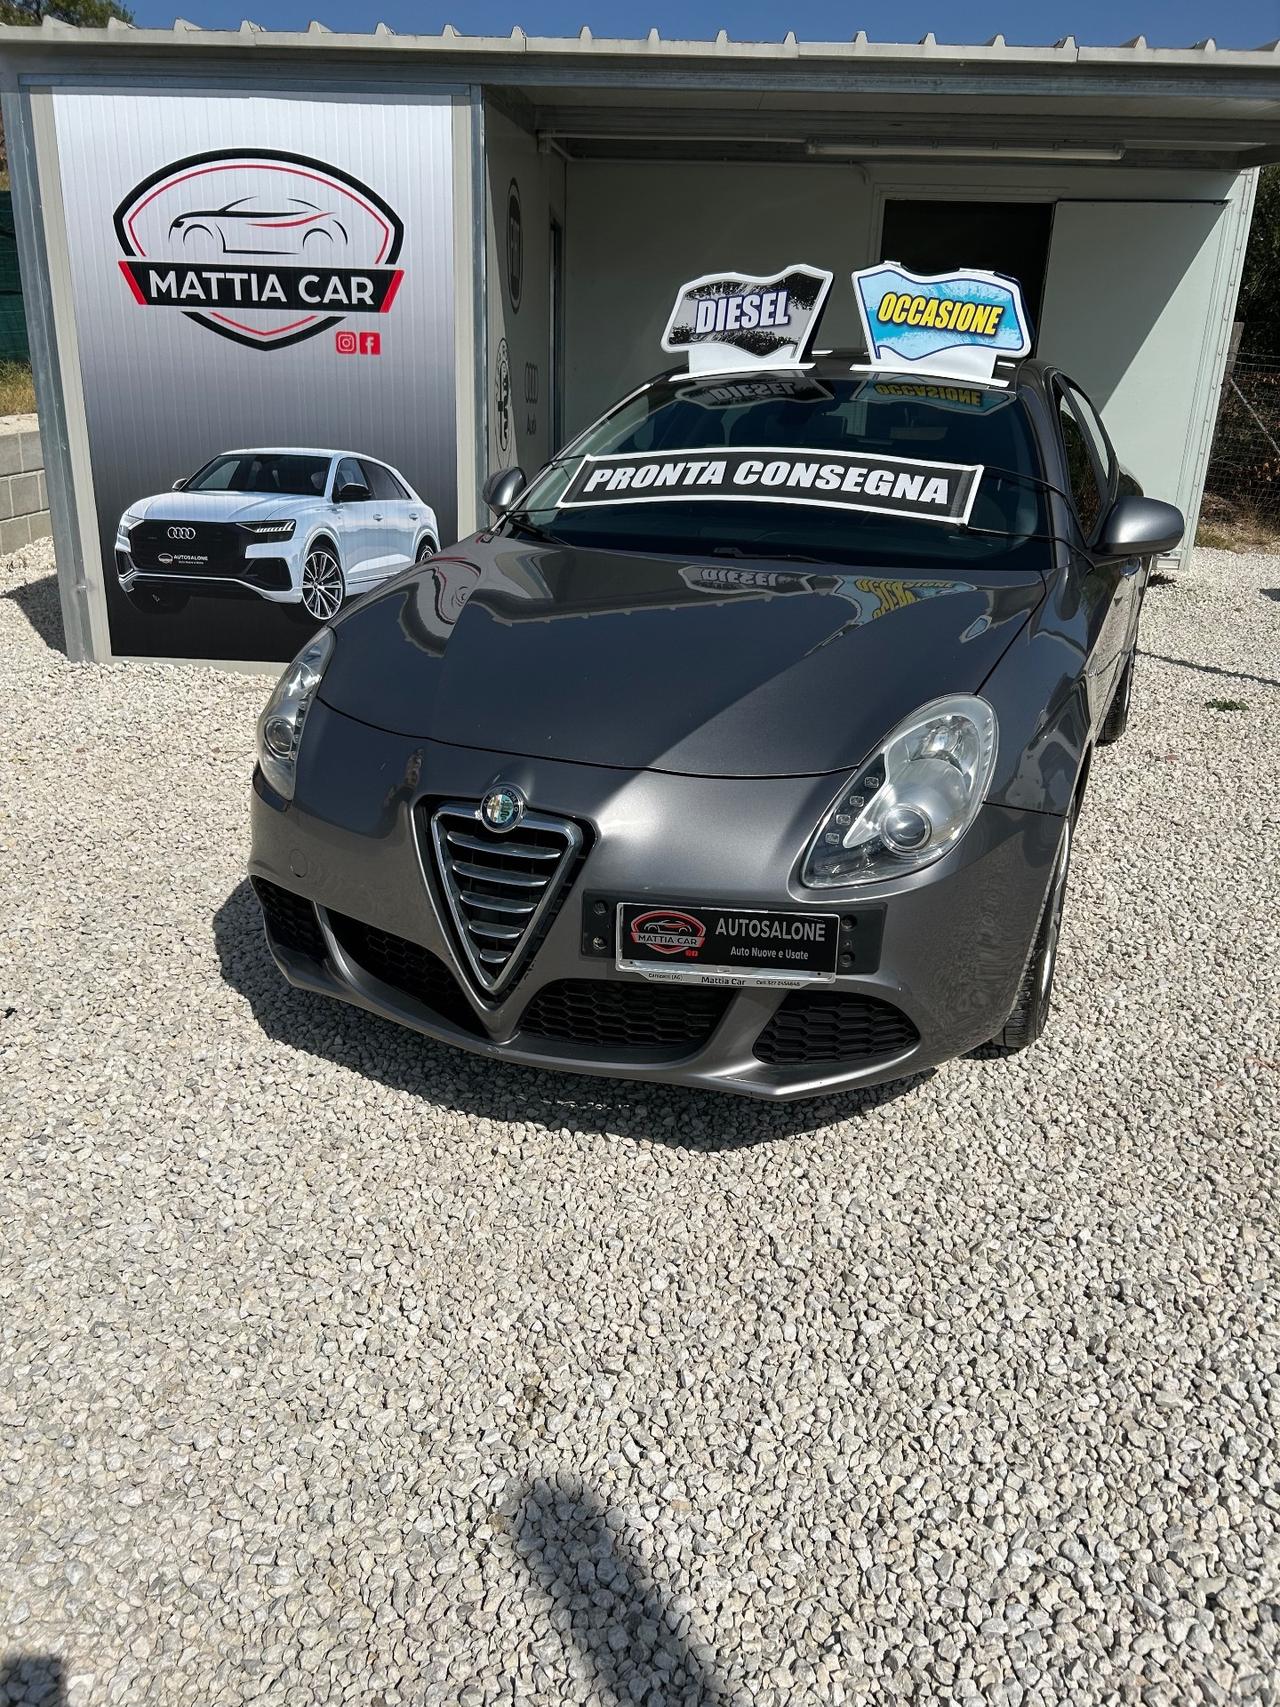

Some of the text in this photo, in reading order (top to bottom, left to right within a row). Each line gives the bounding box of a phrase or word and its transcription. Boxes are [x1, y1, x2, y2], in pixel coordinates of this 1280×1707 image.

[148, 269, 375, 305] MATTIA CAR
[695, 290, 790, 334] DIESEL
[878, 292, 1004, 335] OCCASIONE
[583, 460, 950, 505] PRONTA CONSEGNA
[638, 934, 698, 945] MATTIA CAR
[715, 918, 825, 942] AUTOSALONE
[730, 946, 809, 960] Auto Nuove e Usate
[701, 975, 746, 986] Mattia Car
